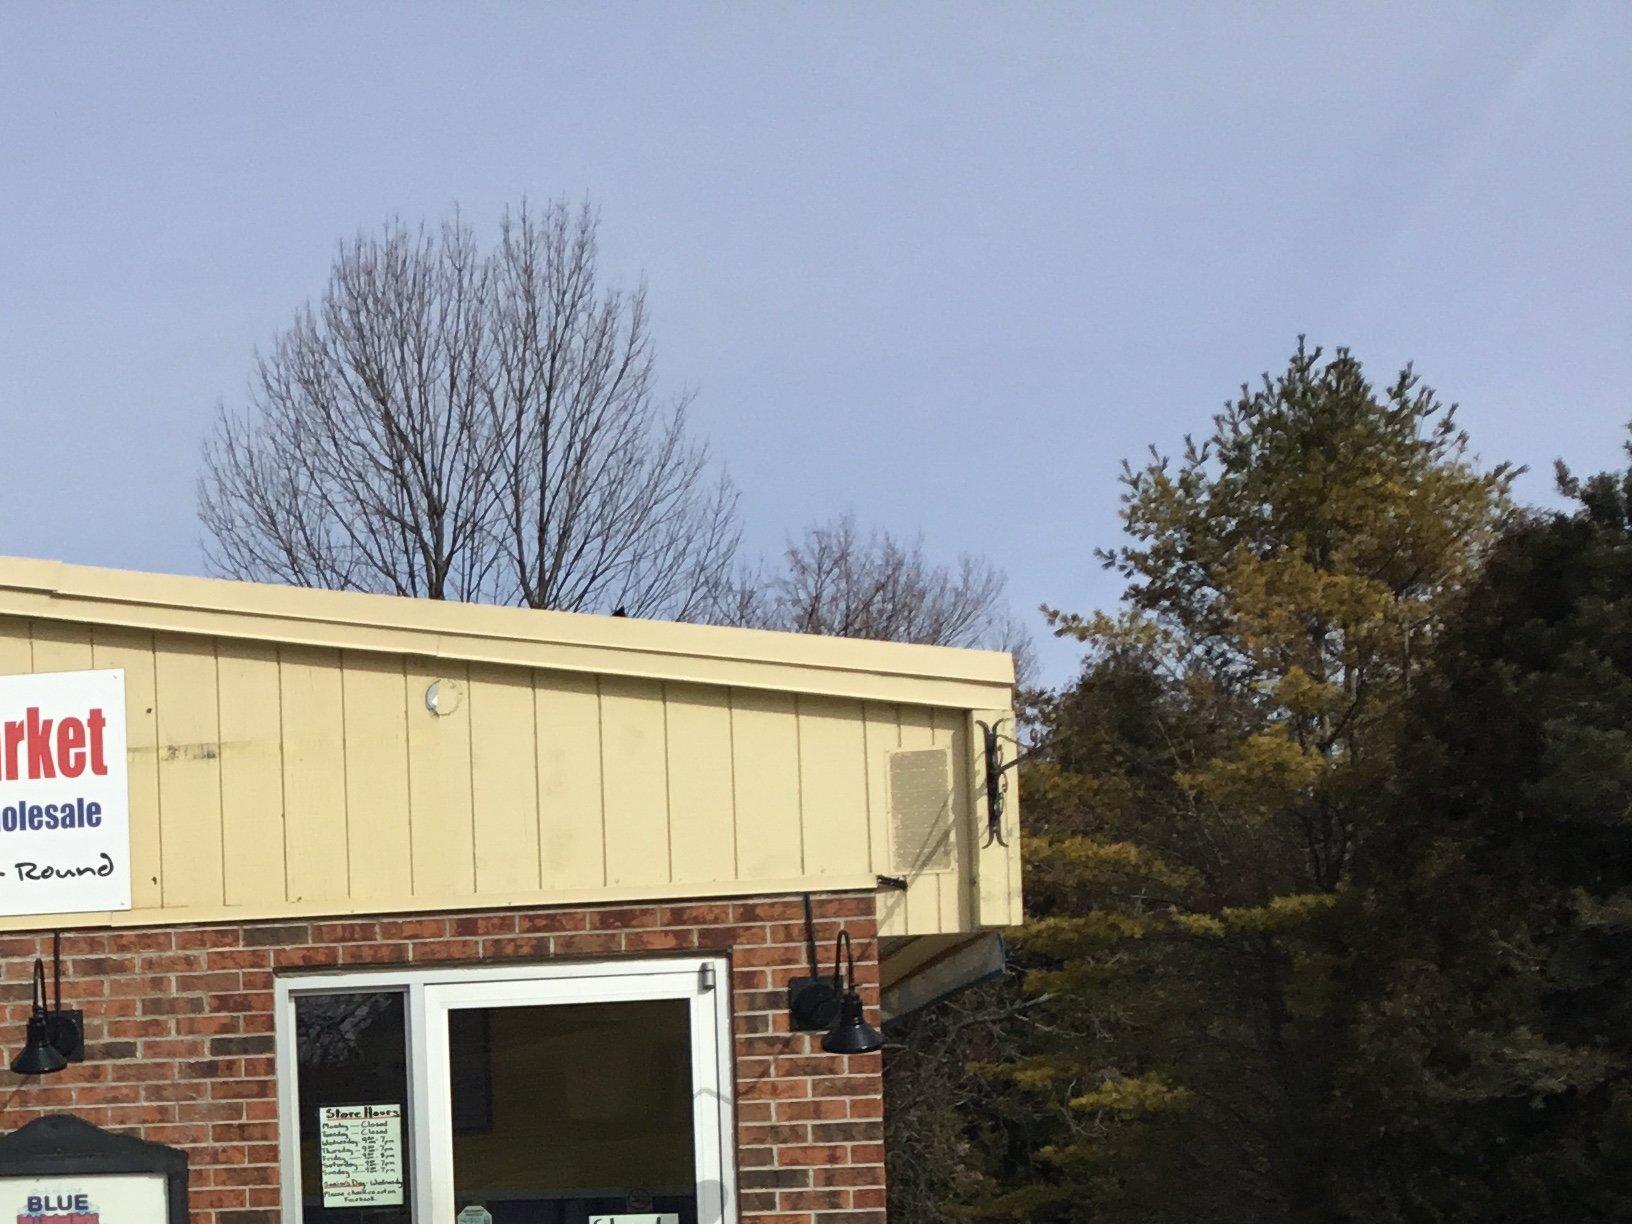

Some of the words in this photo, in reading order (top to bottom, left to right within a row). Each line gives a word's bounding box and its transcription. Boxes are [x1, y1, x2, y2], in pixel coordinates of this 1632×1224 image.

[14, 852, 114, 882] Round
[325, 1107, 361, 1119] Store
[363, 1106, 401, 1119] Hours
[360, 1120, 388, 1129] Closed
[360, 1128, 388, 1136] Closed
[28, 1194, 89, 1212] BLUE
